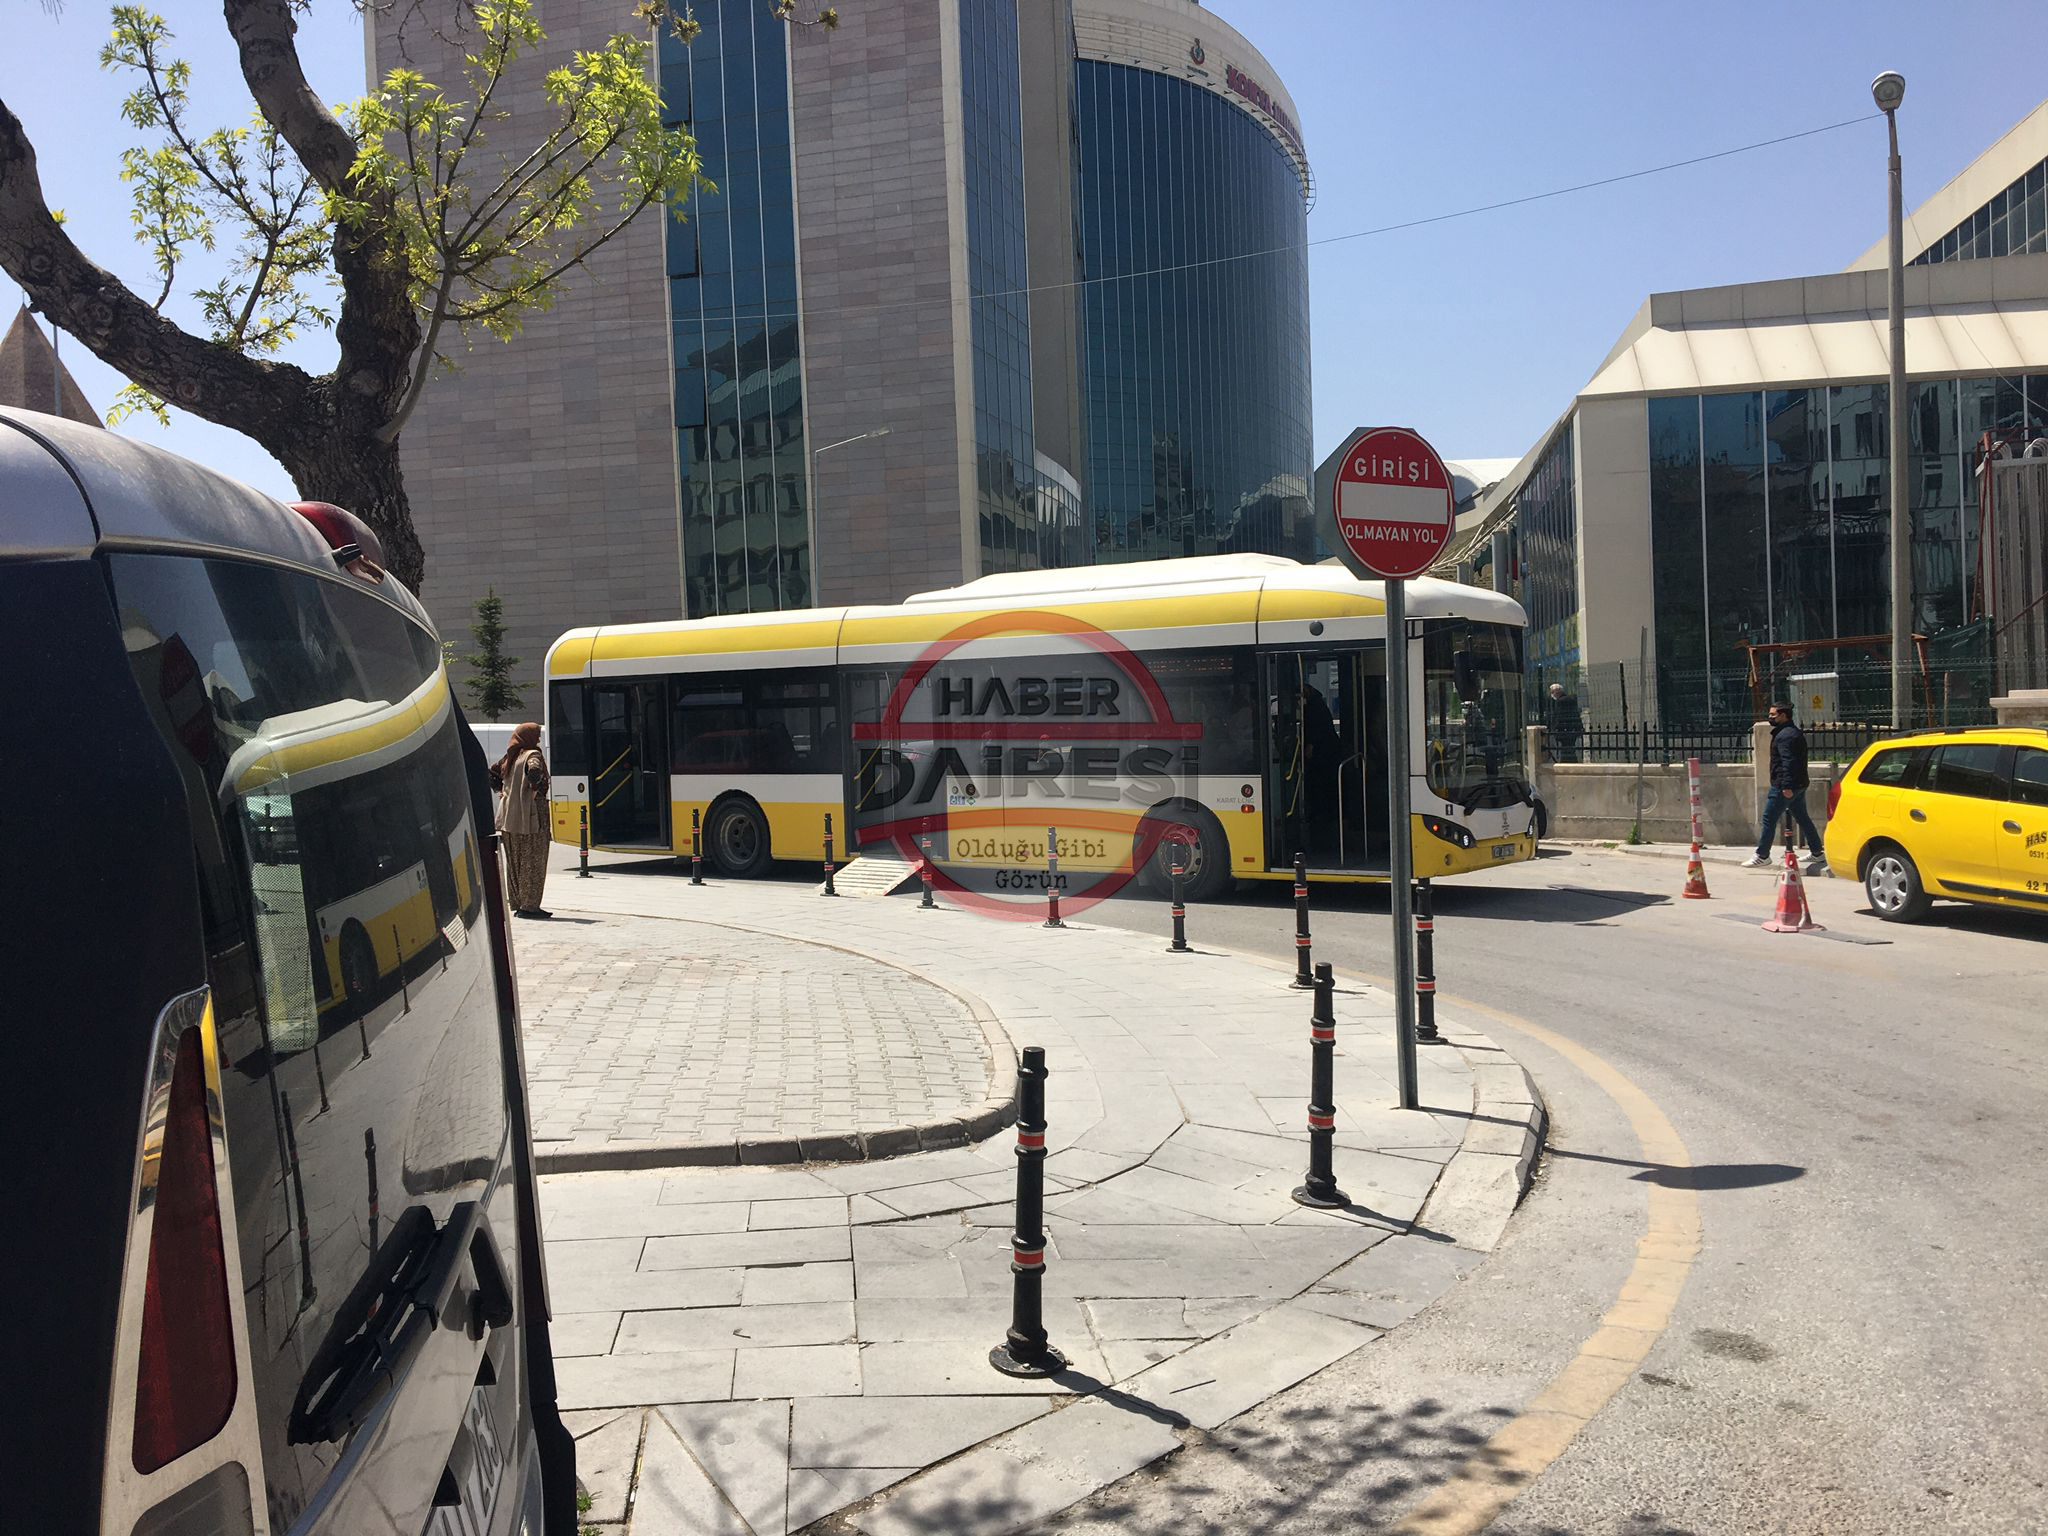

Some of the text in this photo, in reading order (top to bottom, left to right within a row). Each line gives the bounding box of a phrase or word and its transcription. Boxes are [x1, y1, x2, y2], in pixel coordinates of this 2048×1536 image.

[1354, 454, 1429, 482] GİRİŞİ
[1345, 524, 1438, 544] OLMAYAN YOL
[2029, 850, 2044, 859] 0531
[2025, 880, 2039, 891] 42
